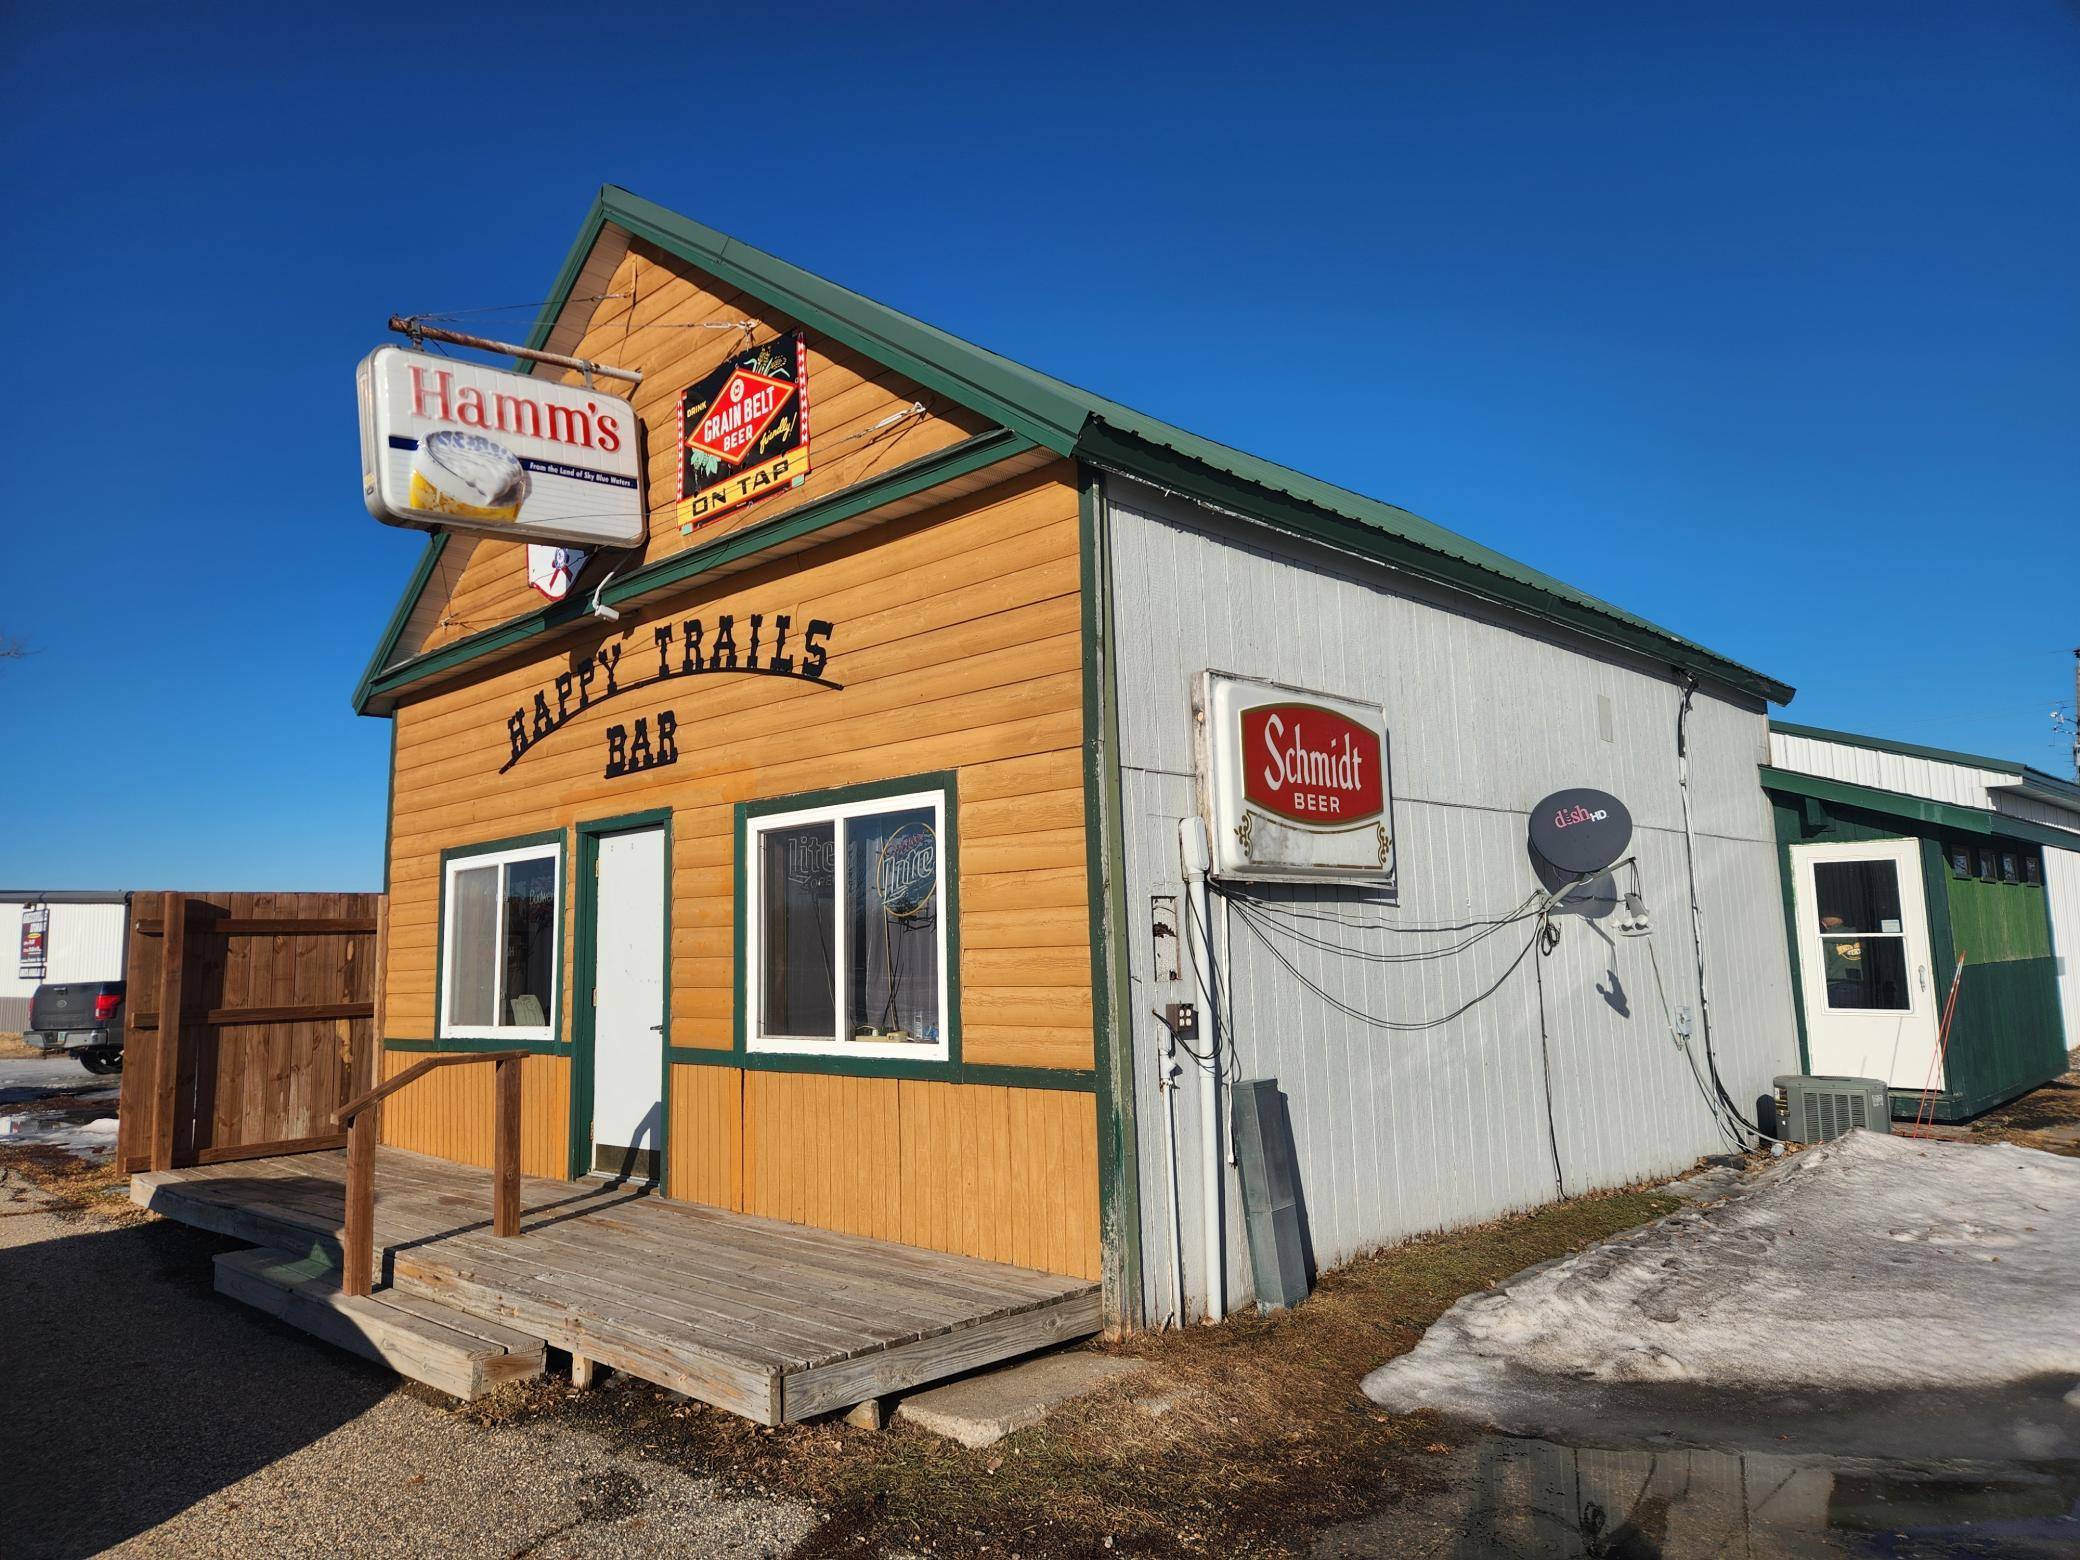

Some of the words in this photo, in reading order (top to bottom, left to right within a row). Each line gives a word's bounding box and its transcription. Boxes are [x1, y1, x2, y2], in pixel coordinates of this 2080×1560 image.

[406, 363, 621, 453] Hamm's
[686, 400, 707, 418] DRINK
[703, 402, 742, 444] GRAIN
[743, 385, 775, 423] BELT
[723, 424, 753, 452] BEER
[529, 462, 547, 472] From
[547, 464, 558, 474] the
[560, 466, 575, 477] Land
[576, 469, 583, 478] of
[584, 471, 595, 481] Sky
[596, 472, 610, 483] Blue
[610, 476, 631, 487] Waters
[692, 487, 727, 517] ON
[737, 459, 789, 496] TAP
[507, 642, 622, 761] HAPPY
[655, 614, 834, 678] TRAILS
[605, 710, 679, 778] BAR
[1264, 713, 1363, 791] Schmidt
[1294, 792, 1340, 813] BEER
[1554, 804, 1591, 828] dish
[1590, 809, 1607, 822] HD
